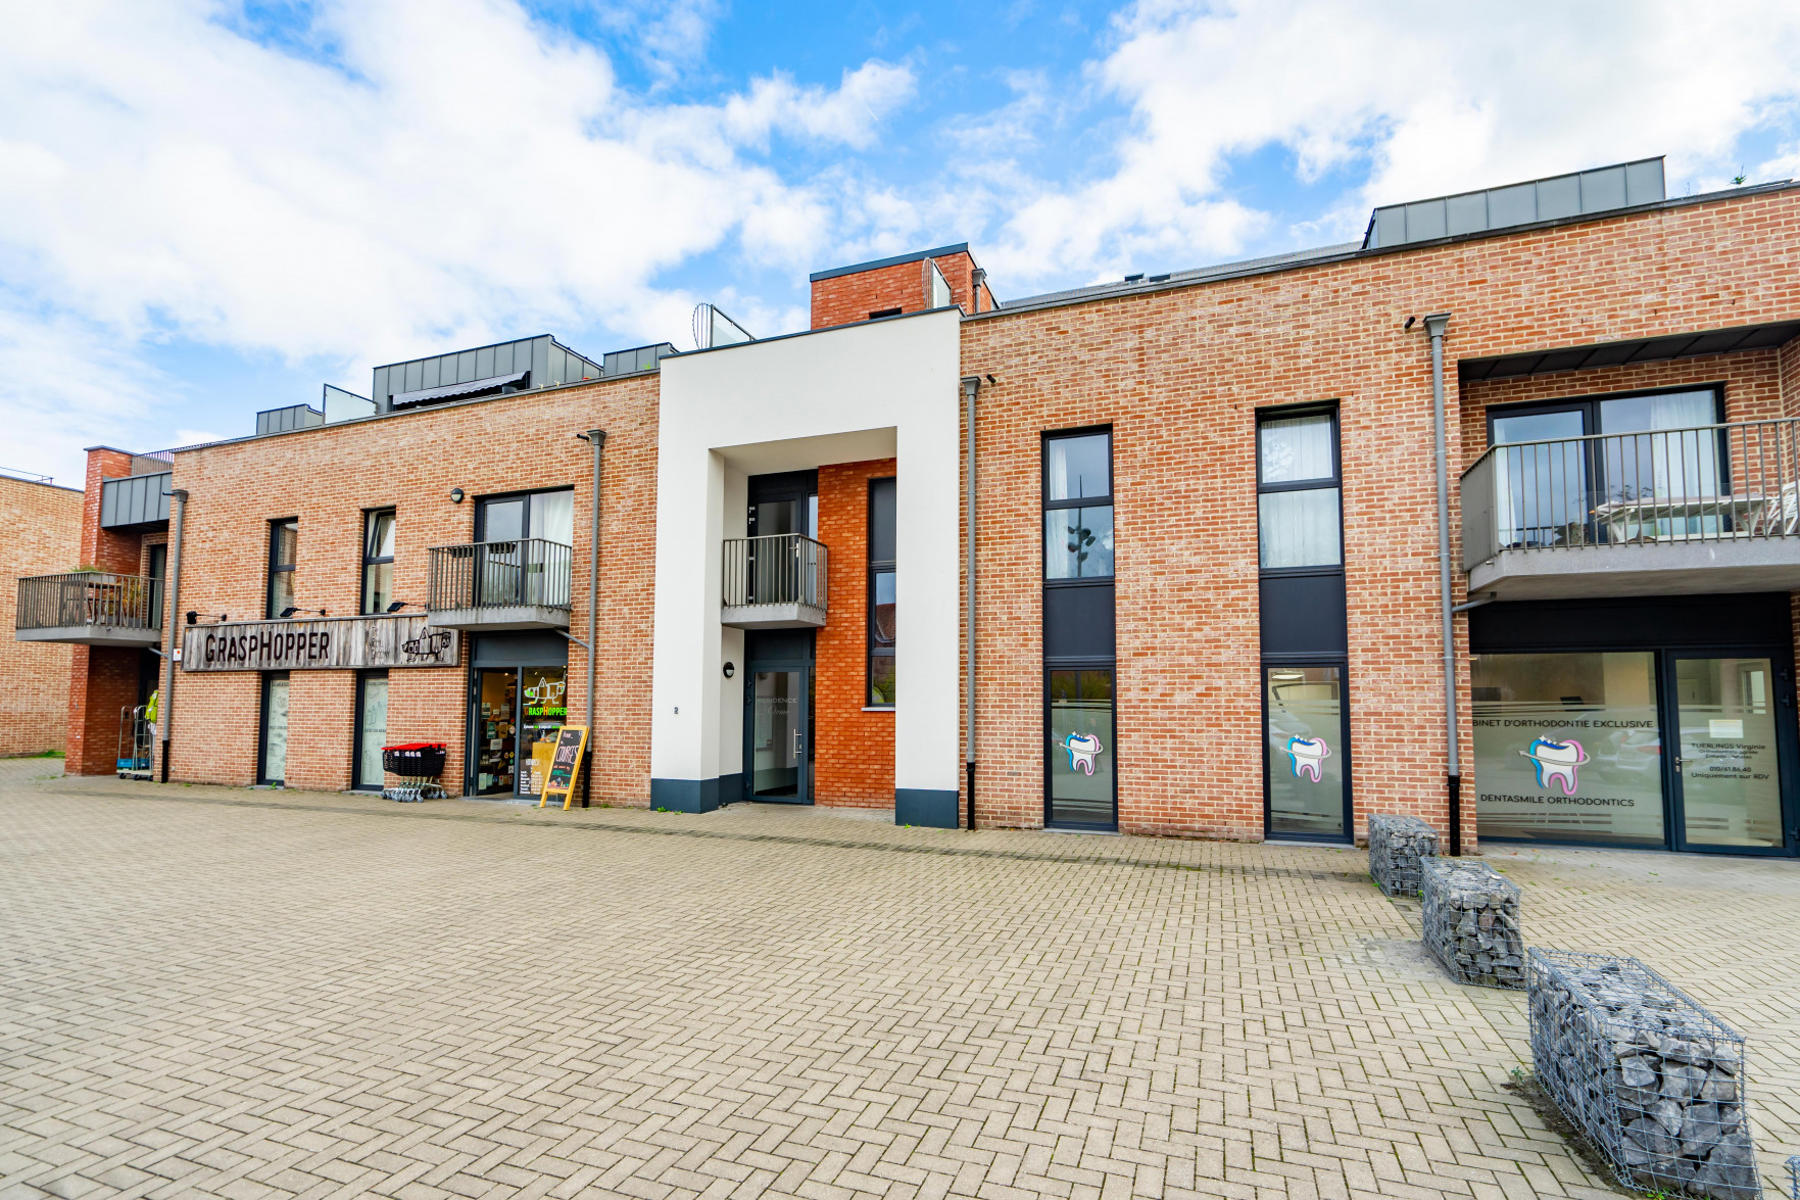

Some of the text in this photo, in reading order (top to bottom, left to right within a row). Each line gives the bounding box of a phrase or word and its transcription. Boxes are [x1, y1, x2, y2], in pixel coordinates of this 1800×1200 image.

[205, 631, 330, 663] GRASPHOPPER
[673, 706, 679, 715] 2
[1504, 719, 1590, 728] D'ORTHODONTIE
[1593, 719, 1654, 728] EXCLUSIVE
[1691, 772, 1737, 780] Uniquement
[1480, 793, 1635, 807] DENTASMILE ORTHODONTICS
